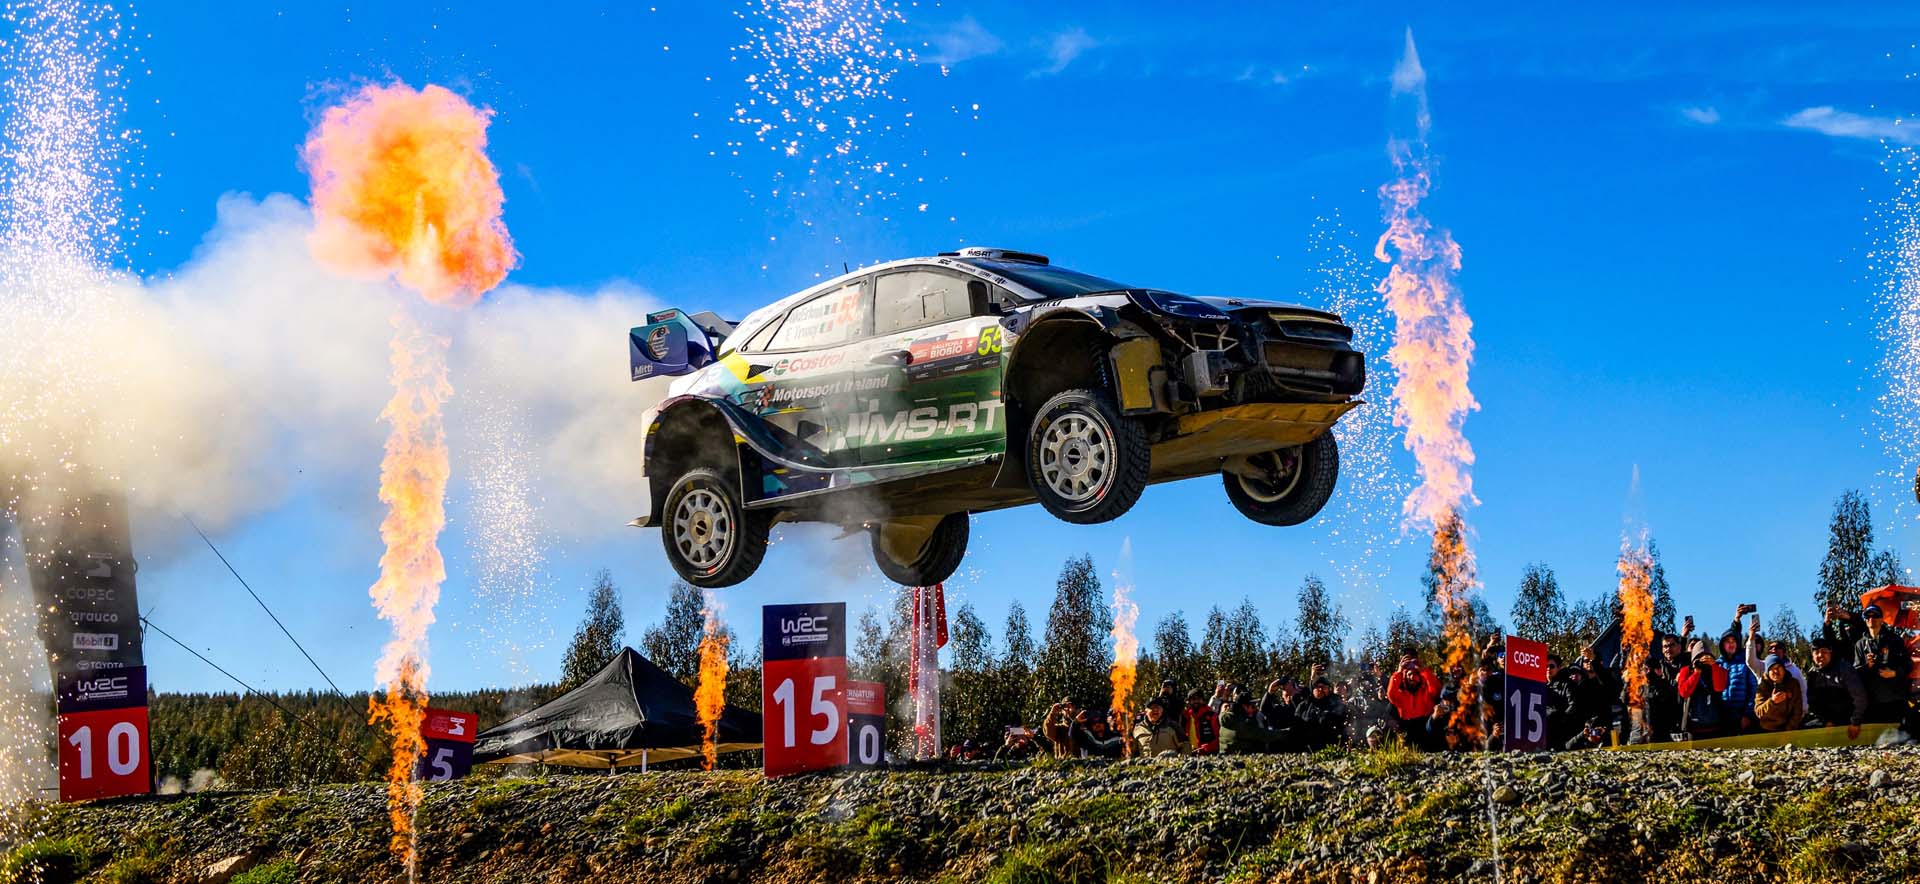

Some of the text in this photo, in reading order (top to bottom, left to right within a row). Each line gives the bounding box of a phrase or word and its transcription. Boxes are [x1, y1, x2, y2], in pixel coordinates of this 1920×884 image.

[977, 325, 1002, 356] 55
[634, 362, 653, 376] Mitti
[789, 352, 845, 373] Castrol
[773, 374, 889, 402] Motorsport Ireland
[66, 587, 115, 601] COPEC
[71, 612, 118, 623] arauco
[781, 616, 828, 634] WRC
[91, 661, 124, 670] TOYOTA
[1513, 650, 1540, 668] COPEC
[78, 676, 128, 692] WRC
[772, 675, 840, 748] 15
[1510, 688, 1543, 743] 15
[69, 721, 140, 779] 10
[431, 747, 454, 781] 5
